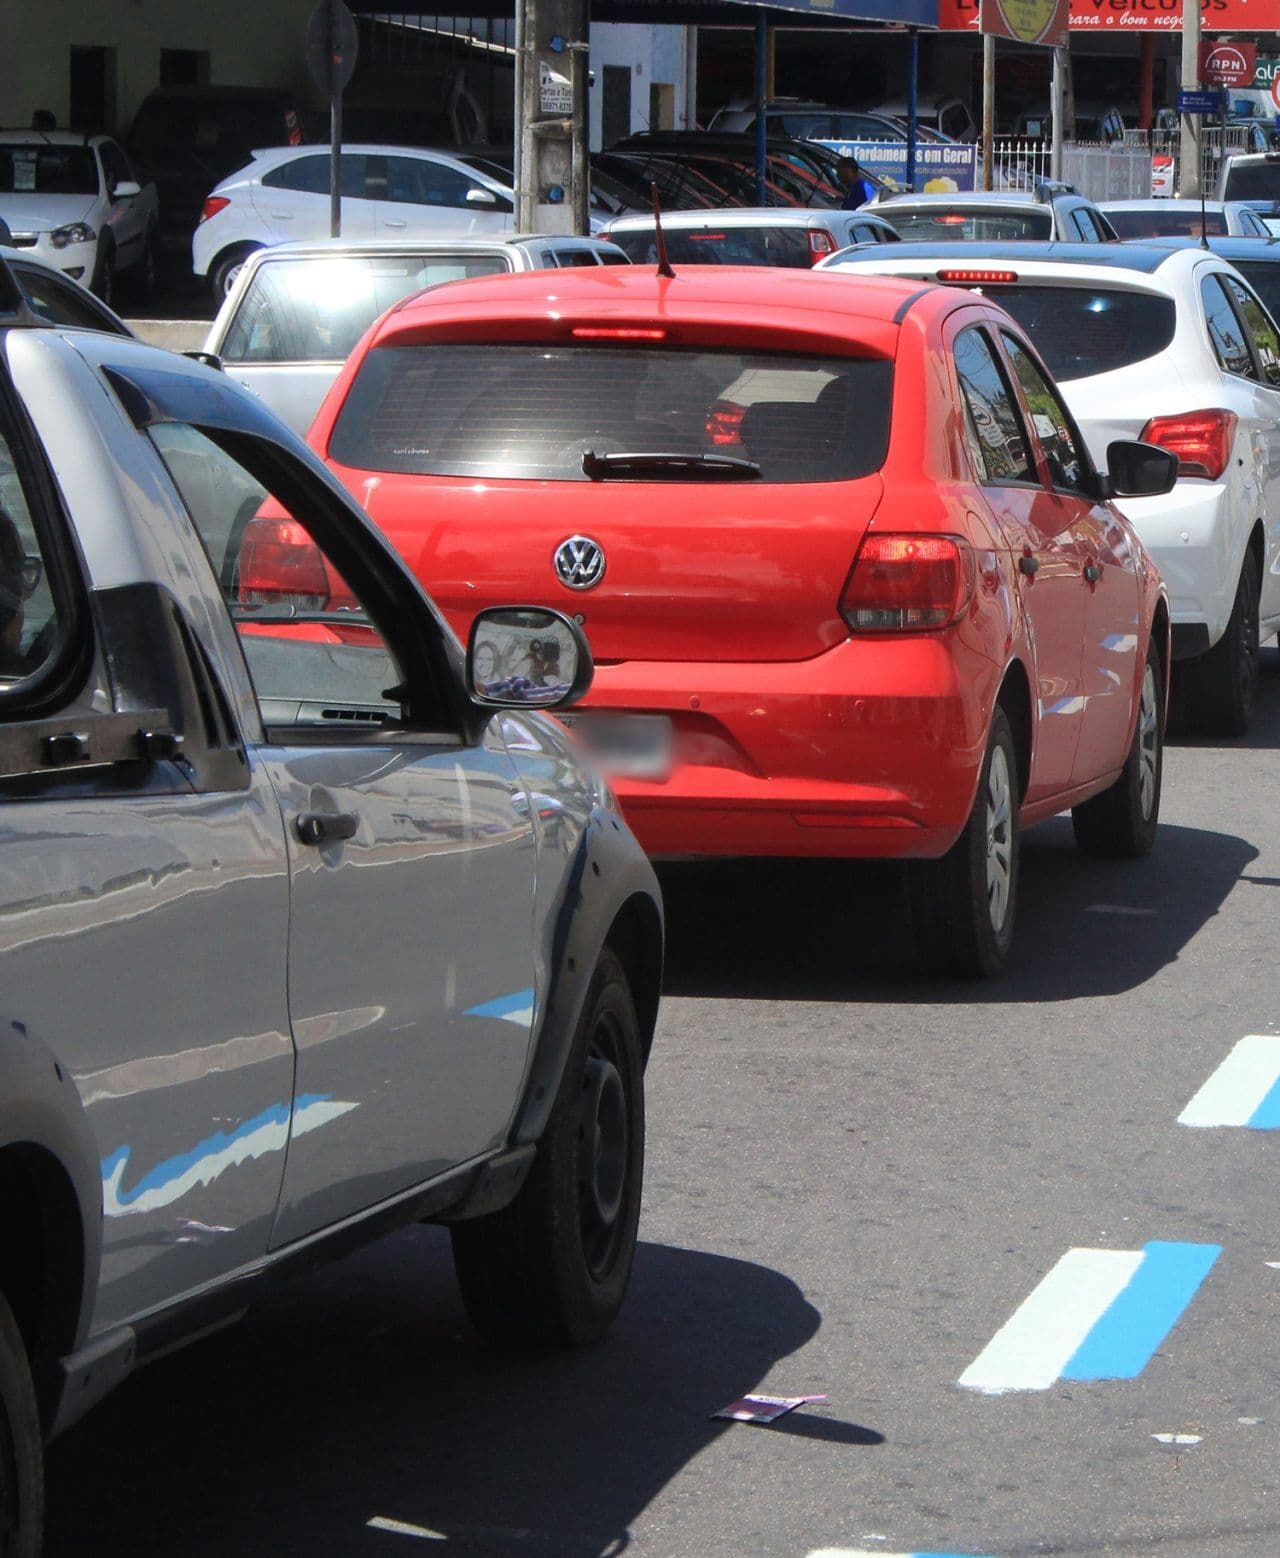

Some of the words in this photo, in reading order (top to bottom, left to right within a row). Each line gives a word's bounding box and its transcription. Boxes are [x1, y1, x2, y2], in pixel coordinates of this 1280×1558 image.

[1212, 59, 1240, 70] RPN
[924, 148, 940, 163] em
[943, 148, 972, 164] Geral
